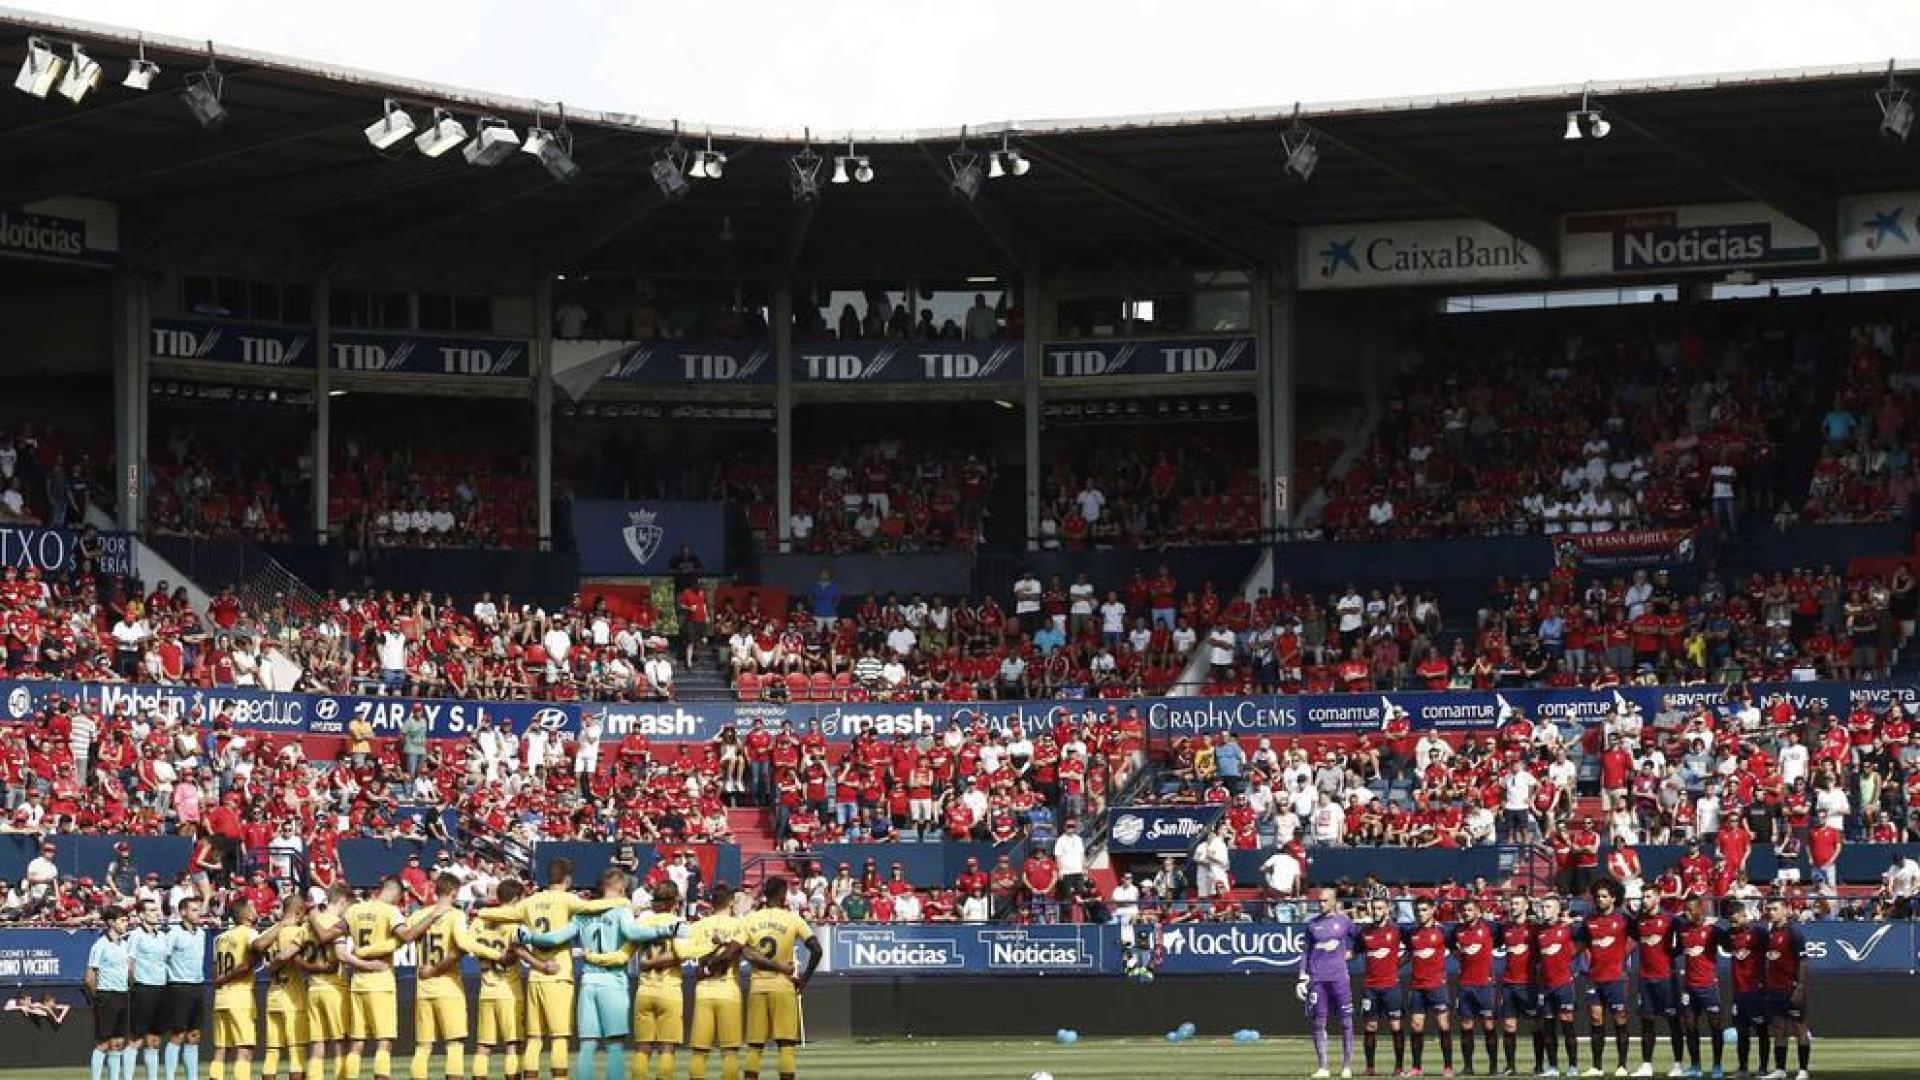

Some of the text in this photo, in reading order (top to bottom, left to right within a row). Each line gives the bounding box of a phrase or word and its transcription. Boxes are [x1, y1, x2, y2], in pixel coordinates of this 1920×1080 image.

[1367, 236, 1528, 271] CaixaBank
[1624, 229, 1765, 265] Noticias
[152, 329, 282, 364] TID TID
[332, 343, 494, 373] TID TID
[681, 354, 738, 379] TID
[801, 353, 979, 380] TID TID
[1048, 346, 1217, 376] TID TID
[0, 528, 64, 571] TXO
[355, 702, 441, 730] ZARY
[608, 707, 697, 734] mash
[842, 707, 935, 735] mash
[854, 942, 948, 965] Noticias
[993, 942, 1077, 964] Noticias
[1188, 926, 1306, 955] lacturale
[23, 957, 59, 976] VICENTE
